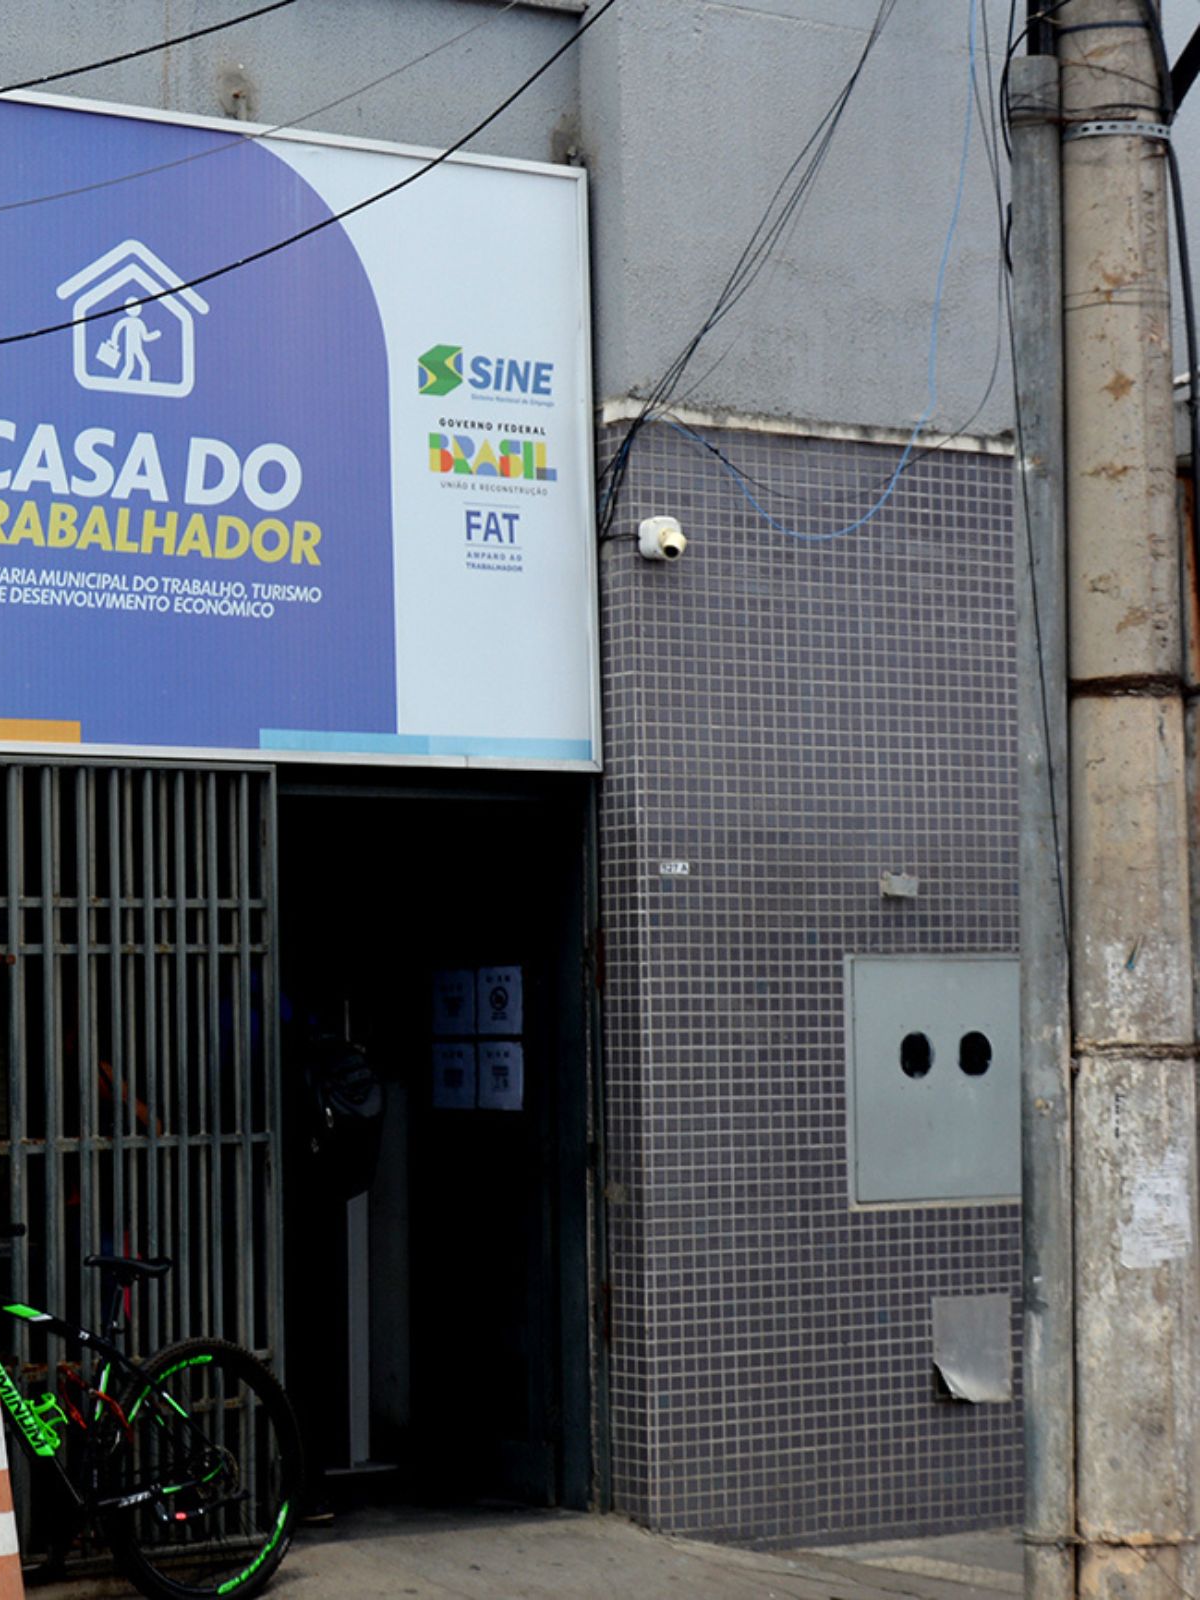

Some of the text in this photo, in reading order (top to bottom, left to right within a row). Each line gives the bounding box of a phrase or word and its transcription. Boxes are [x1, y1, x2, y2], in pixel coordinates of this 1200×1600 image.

[439, 417, 546, 436] GOVERNO FEDERAL
[184, 436, 303, 512] DO
[428, 431, 558, 482] BRASIL
[465, 509, 520, 544] FAT
[9, 587, 170, 613] DESENVOLVIMENTO
[39, 569, 129, 591] MUNICIPAL
[132, 575, 159, 593] DO
[161, 576, 248, 600] TRABALHO,
[251, 582, 323, 604] TURISMO
